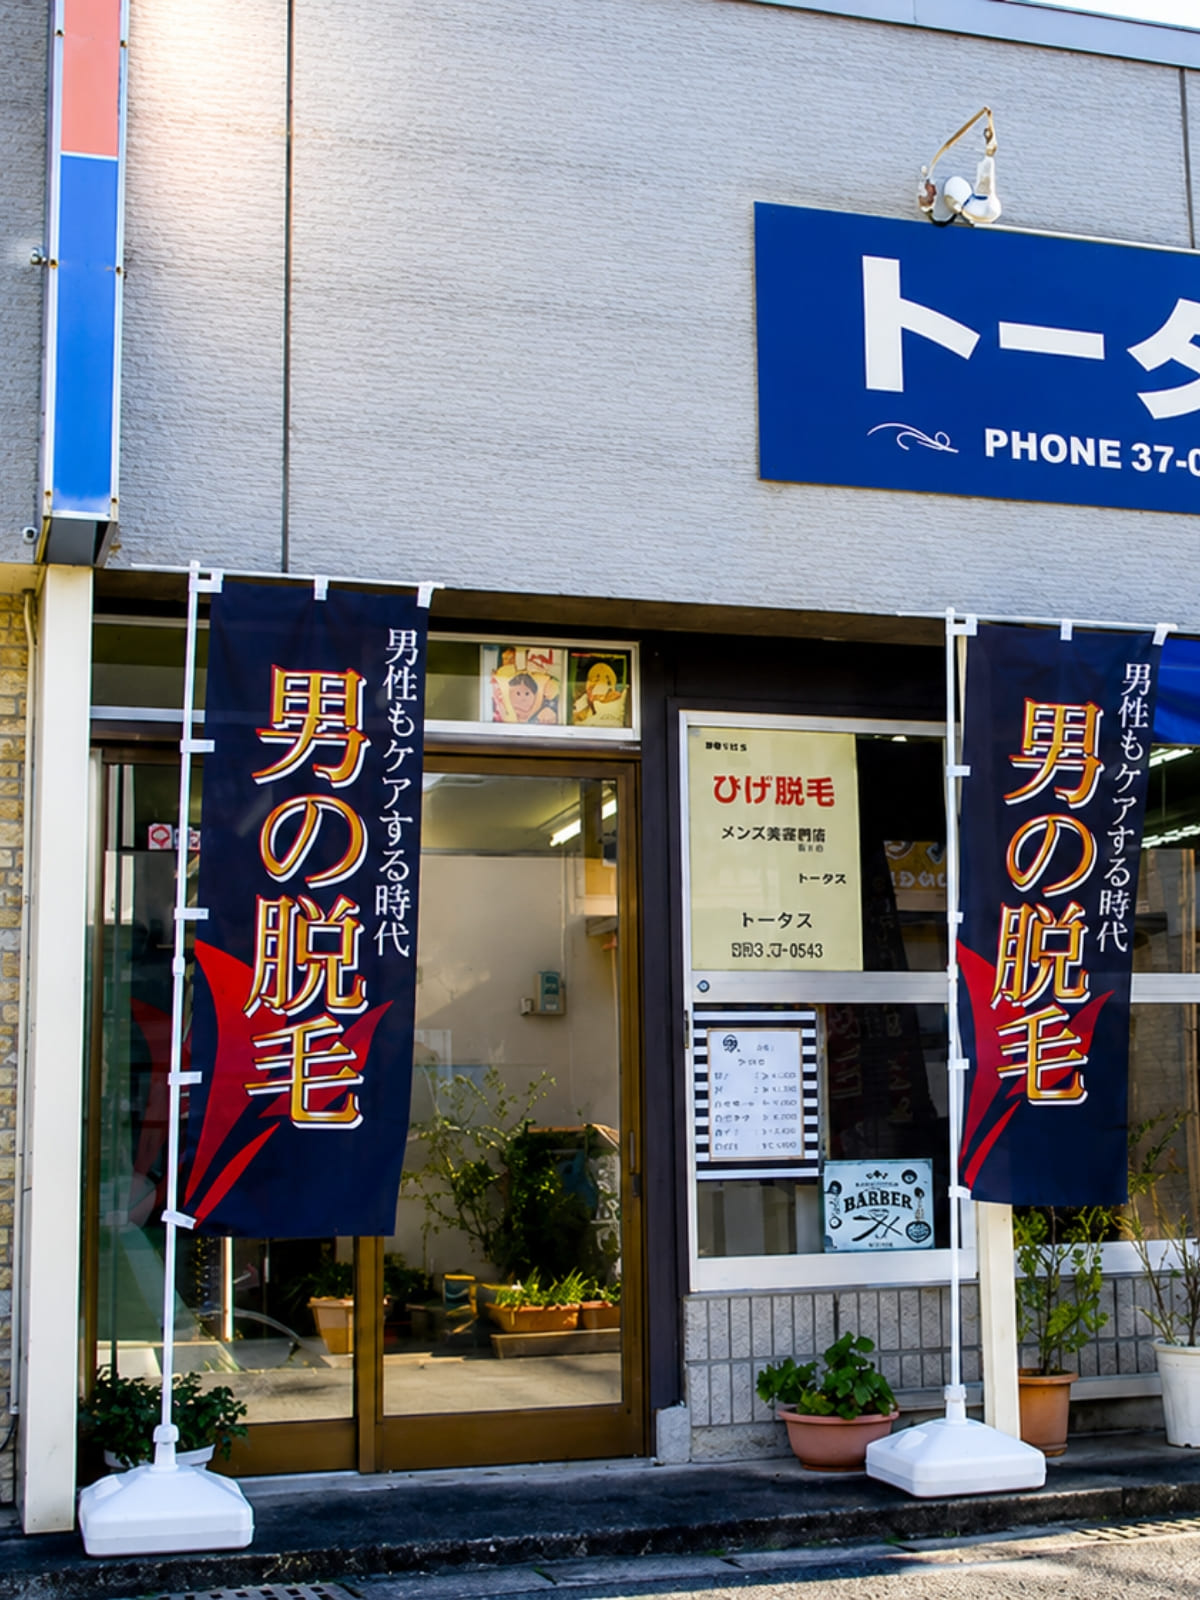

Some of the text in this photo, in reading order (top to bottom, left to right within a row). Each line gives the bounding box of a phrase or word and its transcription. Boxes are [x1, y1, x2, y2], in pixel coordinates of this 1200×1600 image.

[985, 428, 1122, 469] PHONE
[373, 627, 419, 958] 男性もケアする時代
[1096, 662, 1152, 954] 男性もケアする時代
[244, 664, 369, 1131] 男の脱毛
[742, 911, 813, 929] トータス
[798, 872, 847, 885] トータス
[989, 697, 1105, 1106] 男の脱毛
[844, 1190, 913, 1213] BARBER
